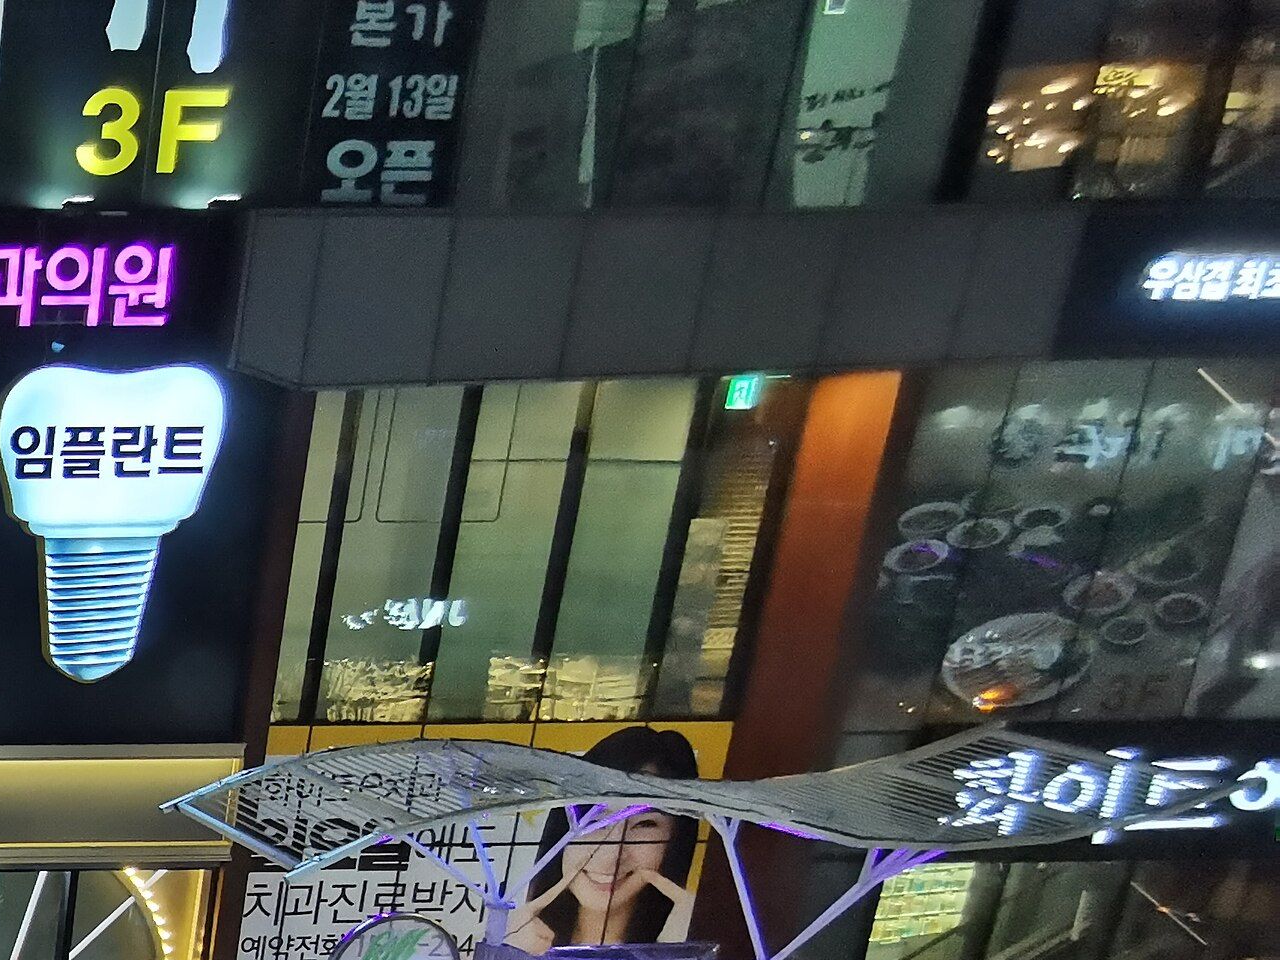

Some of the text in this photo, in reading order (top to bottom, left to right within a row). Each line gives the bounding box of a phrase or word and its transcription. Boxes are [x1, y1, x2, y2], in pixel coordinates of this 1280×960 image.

[325, 71, 458, 122] 2월 13일
[75, 86, 231, 177] 3F
[325, 138, 435, 204] 오픈
[8, 424, 205, 480] 임플란트
